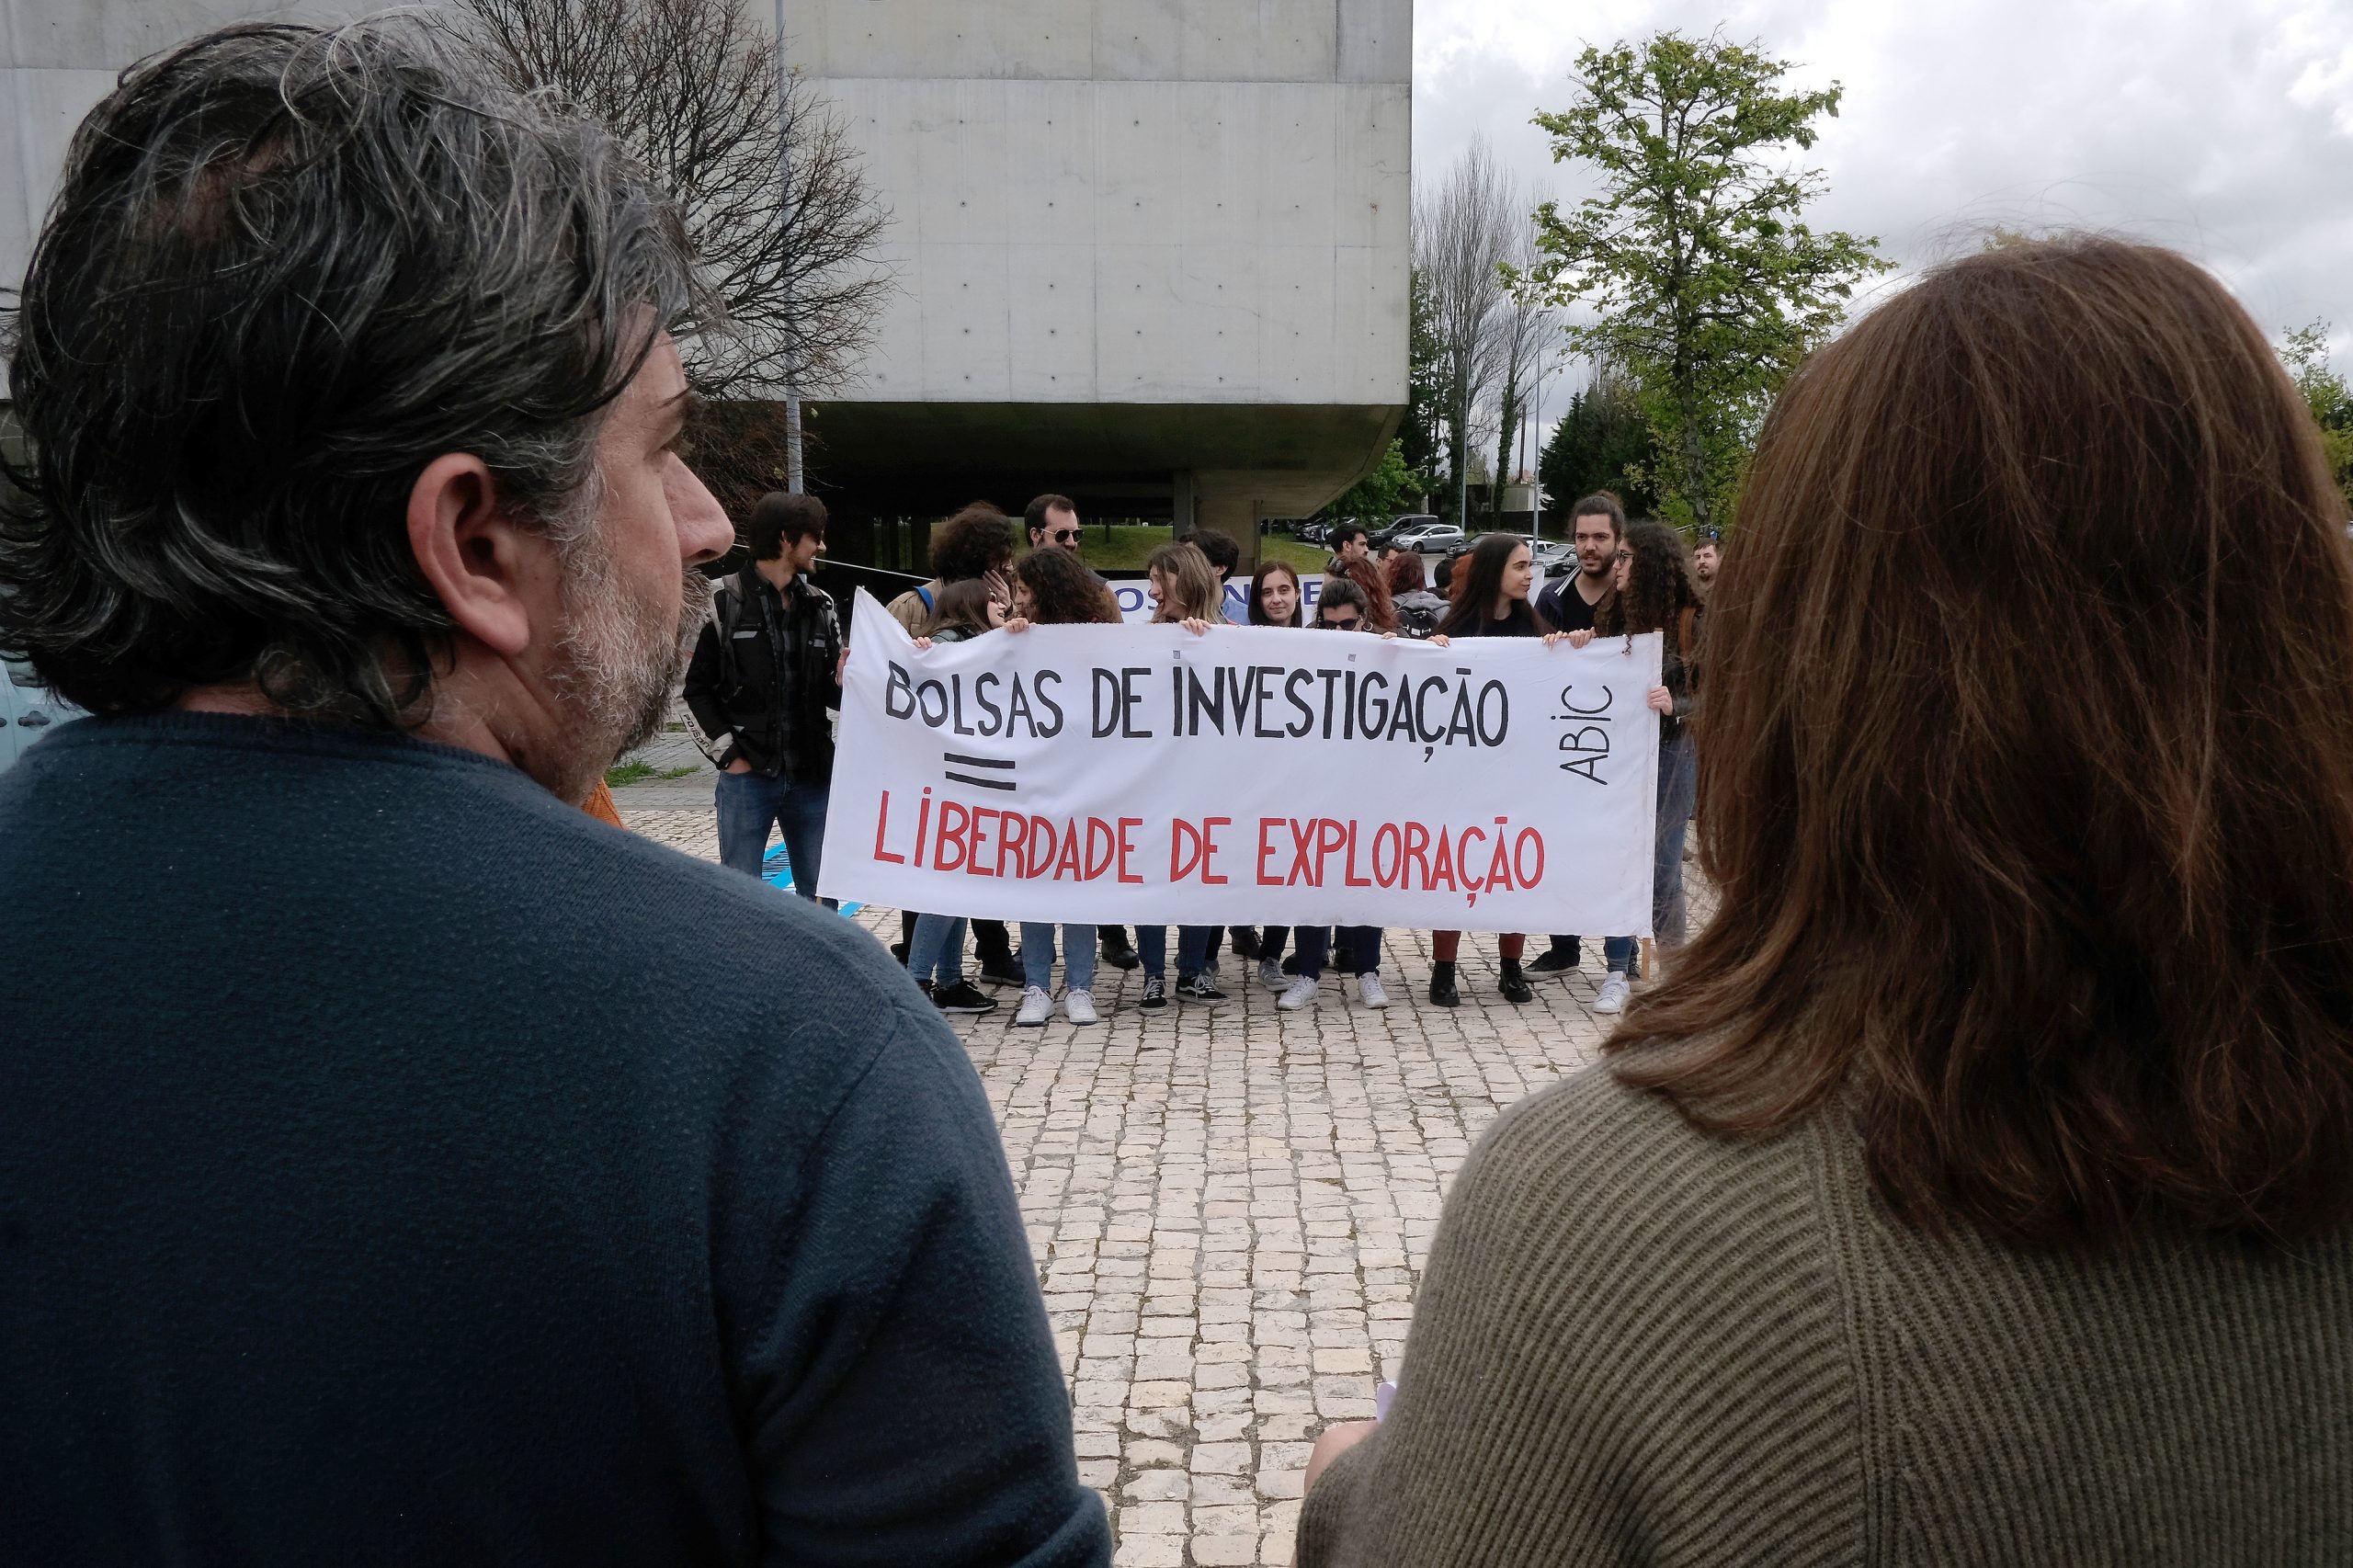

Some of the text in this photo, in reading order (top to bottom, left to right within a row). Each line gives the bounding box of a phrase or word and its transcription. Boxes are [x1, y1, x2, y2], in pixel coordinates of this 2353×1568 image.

[885, 659, 1064, 739] BOLSAS
[1091, 667, 1154, 739] DE
[1169, 816, 1232, 885] DE
[1256, 815, 1545, 908] EXPLORAÇÃO
